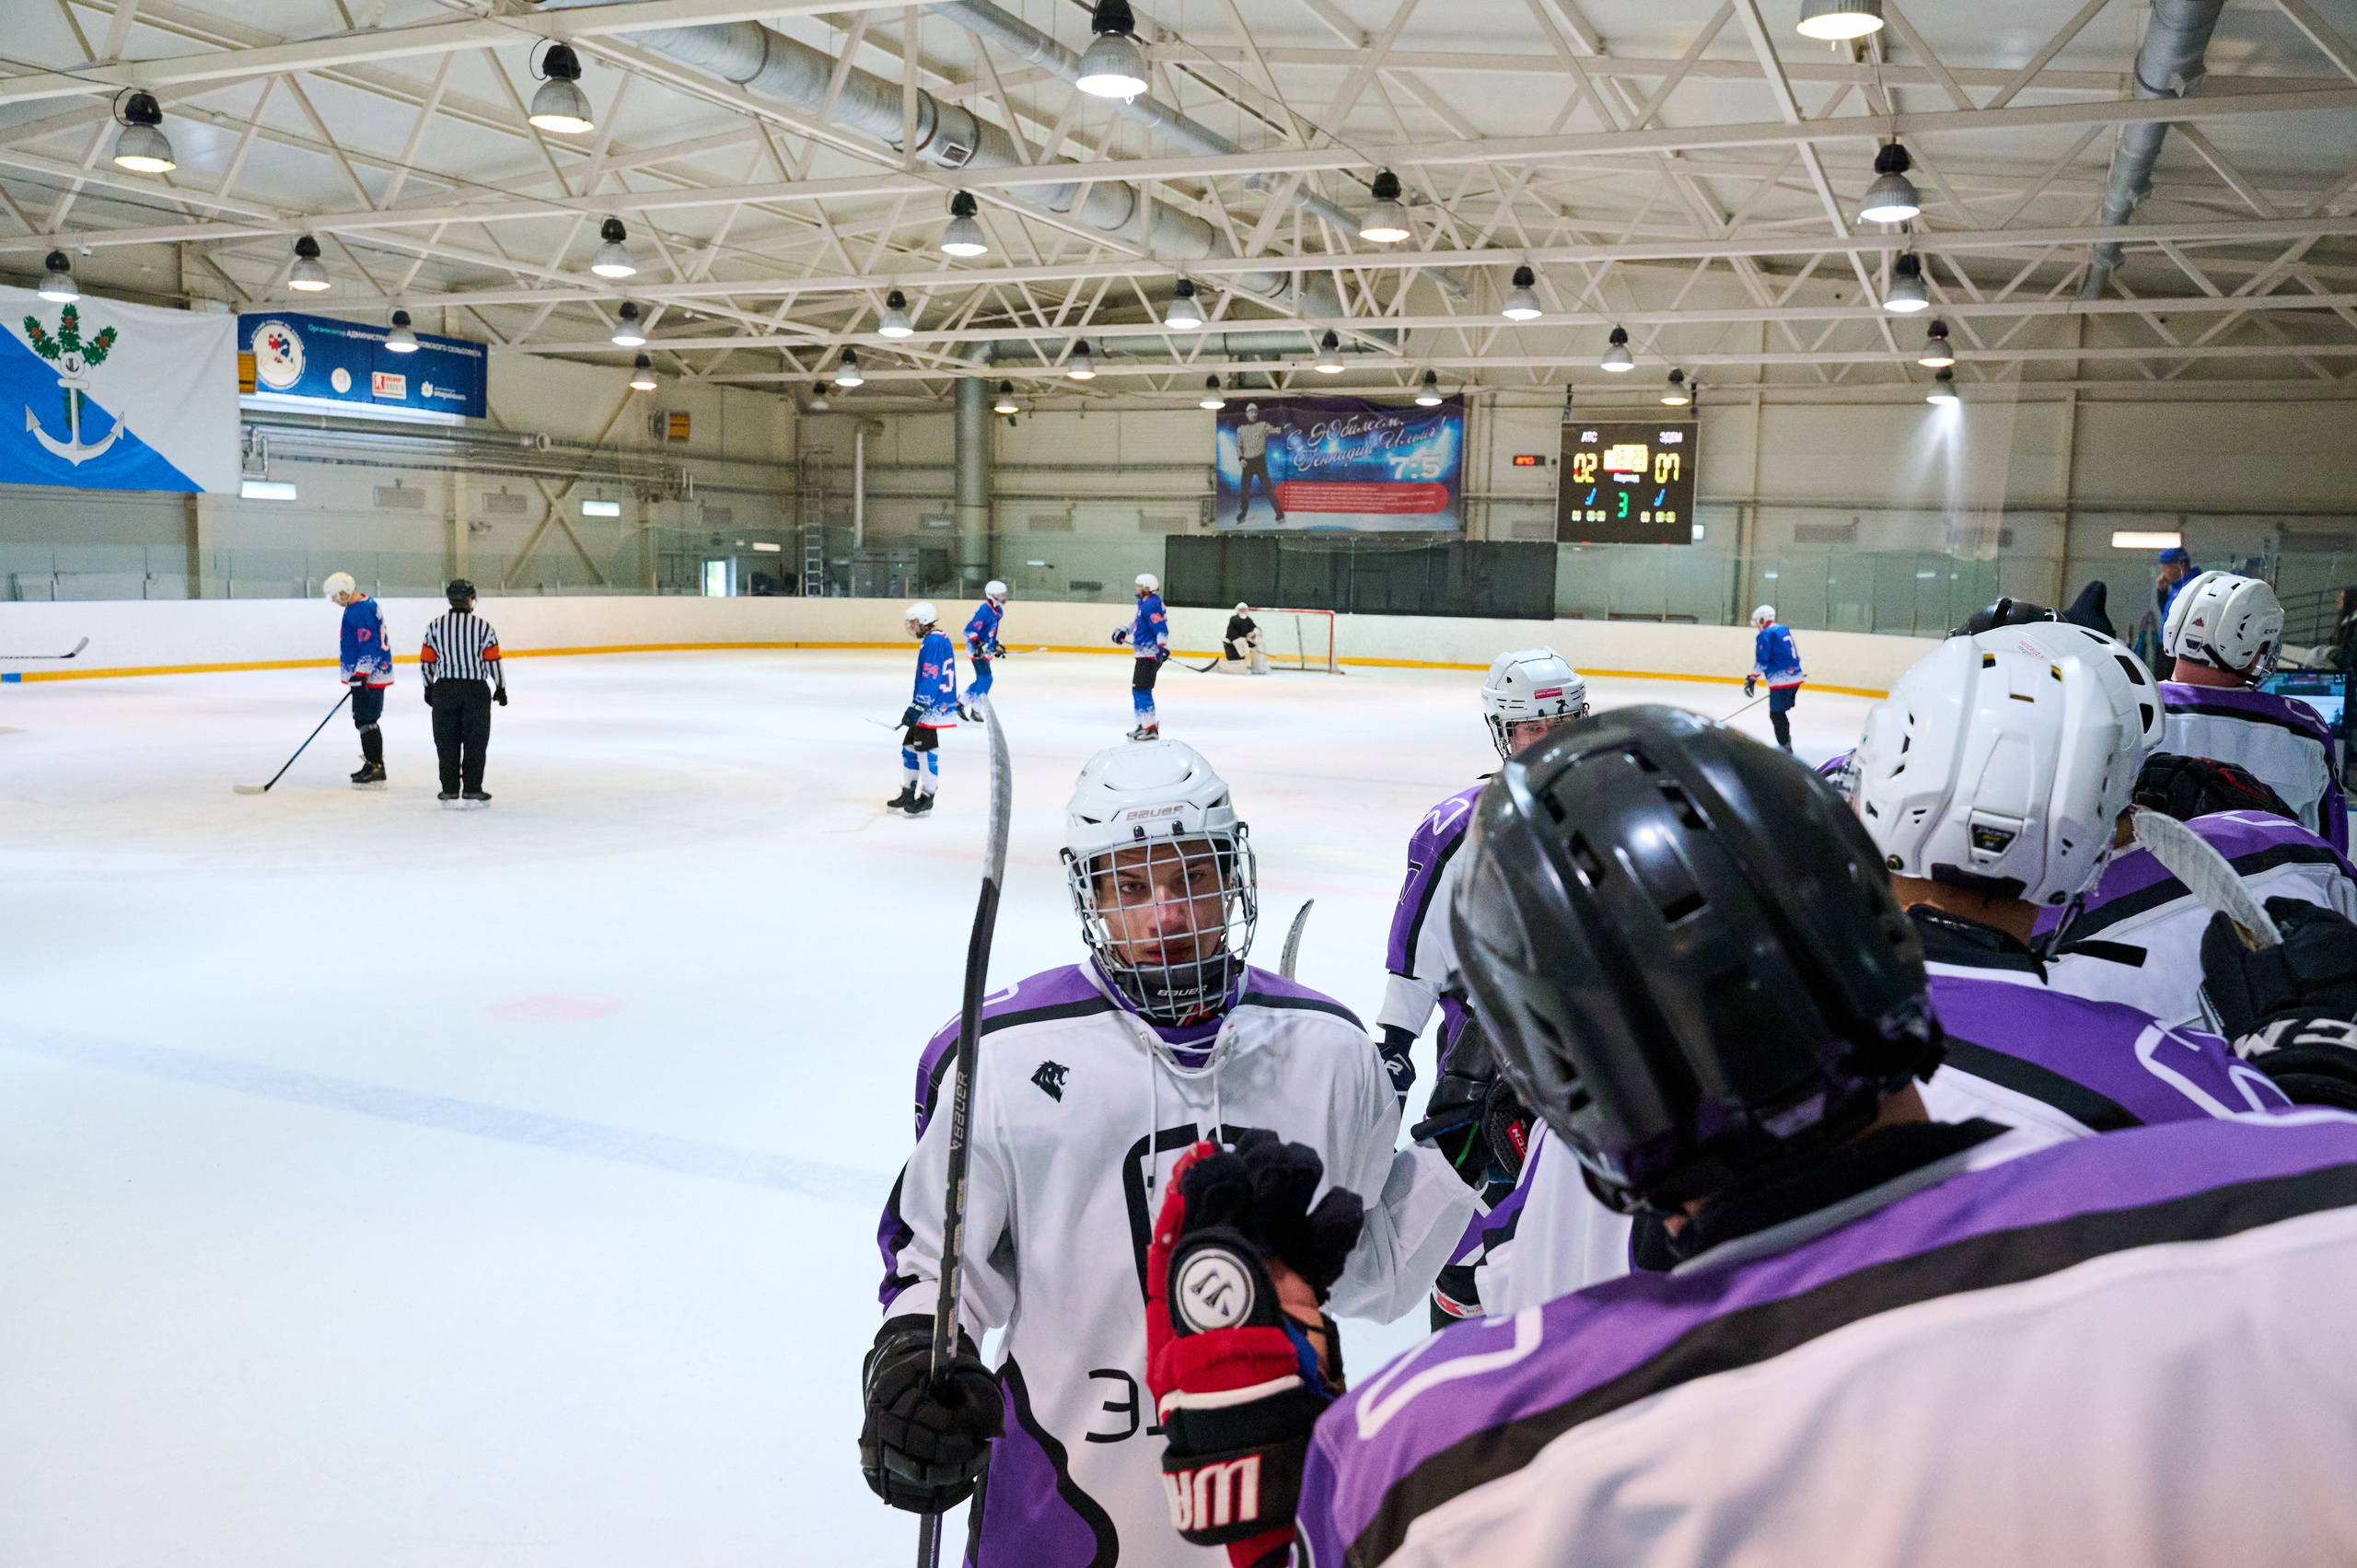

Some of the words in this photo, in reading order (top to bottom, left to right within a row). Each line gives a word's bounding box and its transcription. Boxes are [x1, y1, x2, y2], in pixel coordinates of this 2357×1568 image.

[1293, 443, 1374, 472] Геннадий
[1617, 491, 1629, 518] 3
[1125, 804, 1185, 821] BAUER
[1156, 984, 1208, 997] BAUER
[953, 1071, 970, 1143] BAUER
[1163, 1455, 1262, 1531] WA
